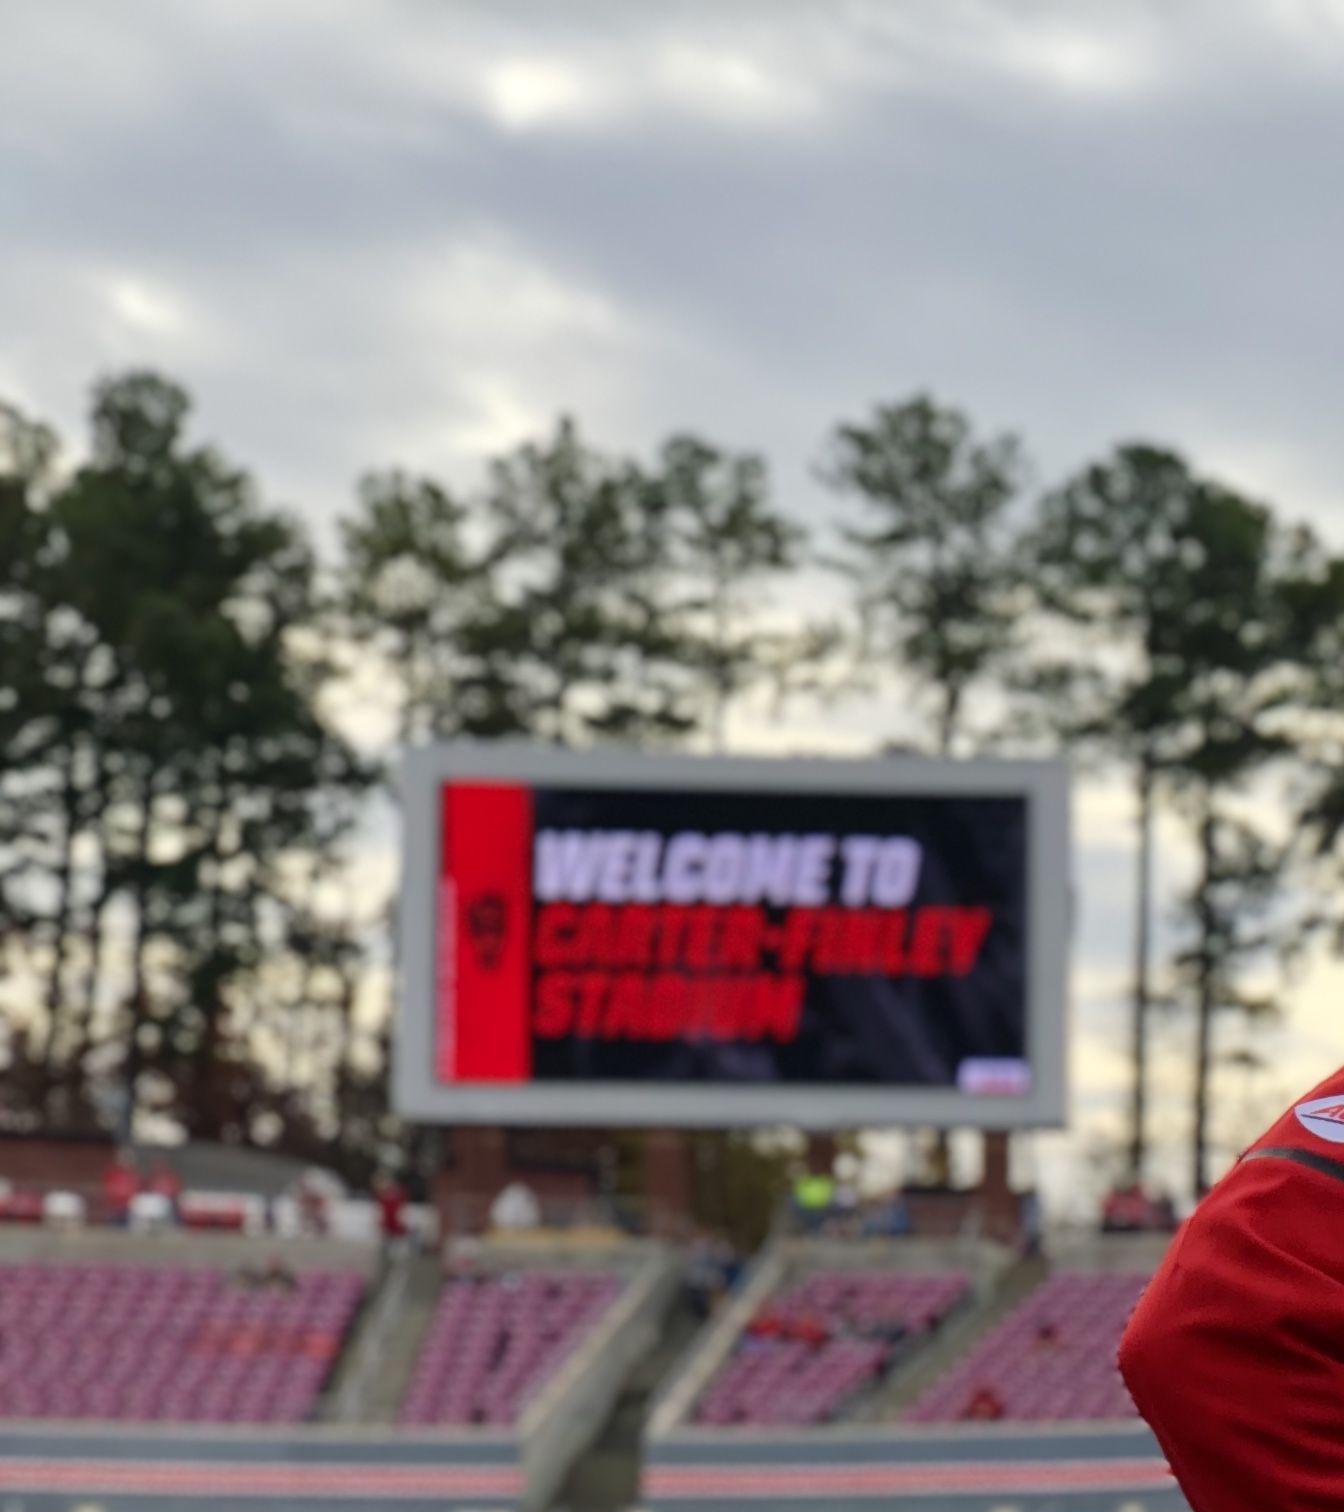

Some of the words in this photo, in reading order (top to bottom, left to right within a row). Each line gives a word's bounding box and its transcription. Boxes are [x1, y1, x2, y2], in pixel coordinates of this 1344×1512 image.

[533, 830, 834, 906] WELCOME
[839, 836, 922, 907] TO
[533, 904, 992, 978] CARTER-FINLEY
[533, 972, 806, 1042] STADIUM
